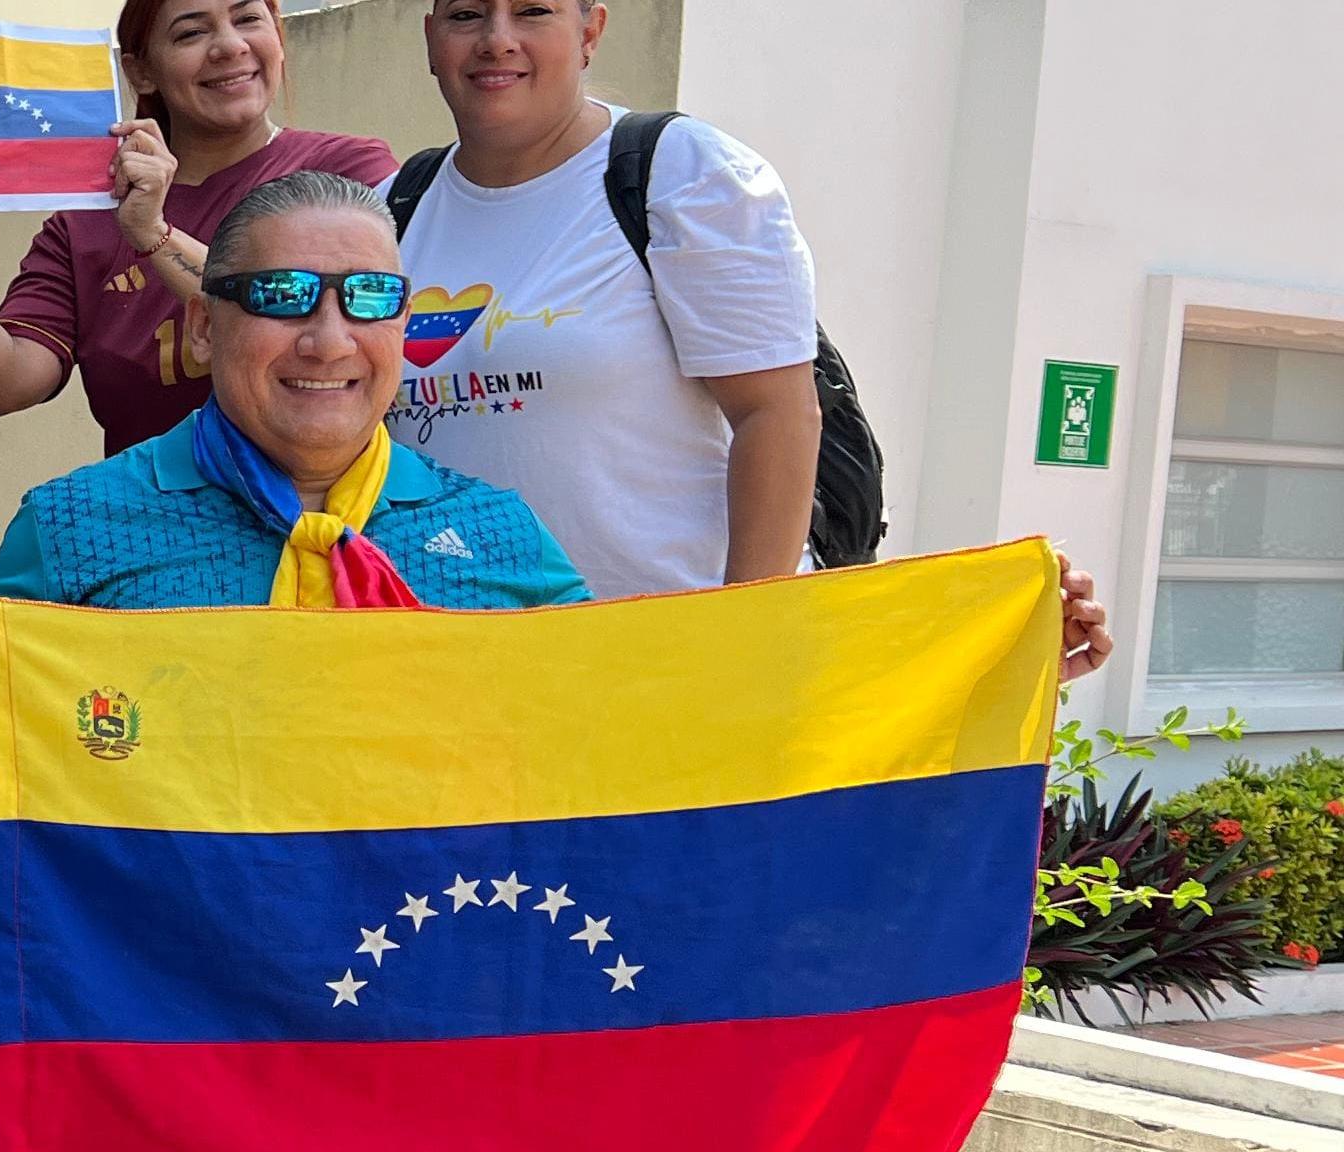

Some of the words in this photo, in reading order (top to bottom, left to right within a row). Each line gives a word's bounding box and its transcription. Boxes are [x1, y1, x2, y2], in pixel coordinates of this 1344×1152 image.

[391, 371, 486, 409] EZUELA
[484, 373, 510, 394] EN
[516, 371, 543, 391] MI
[424, 542, 473, 560] adidas
